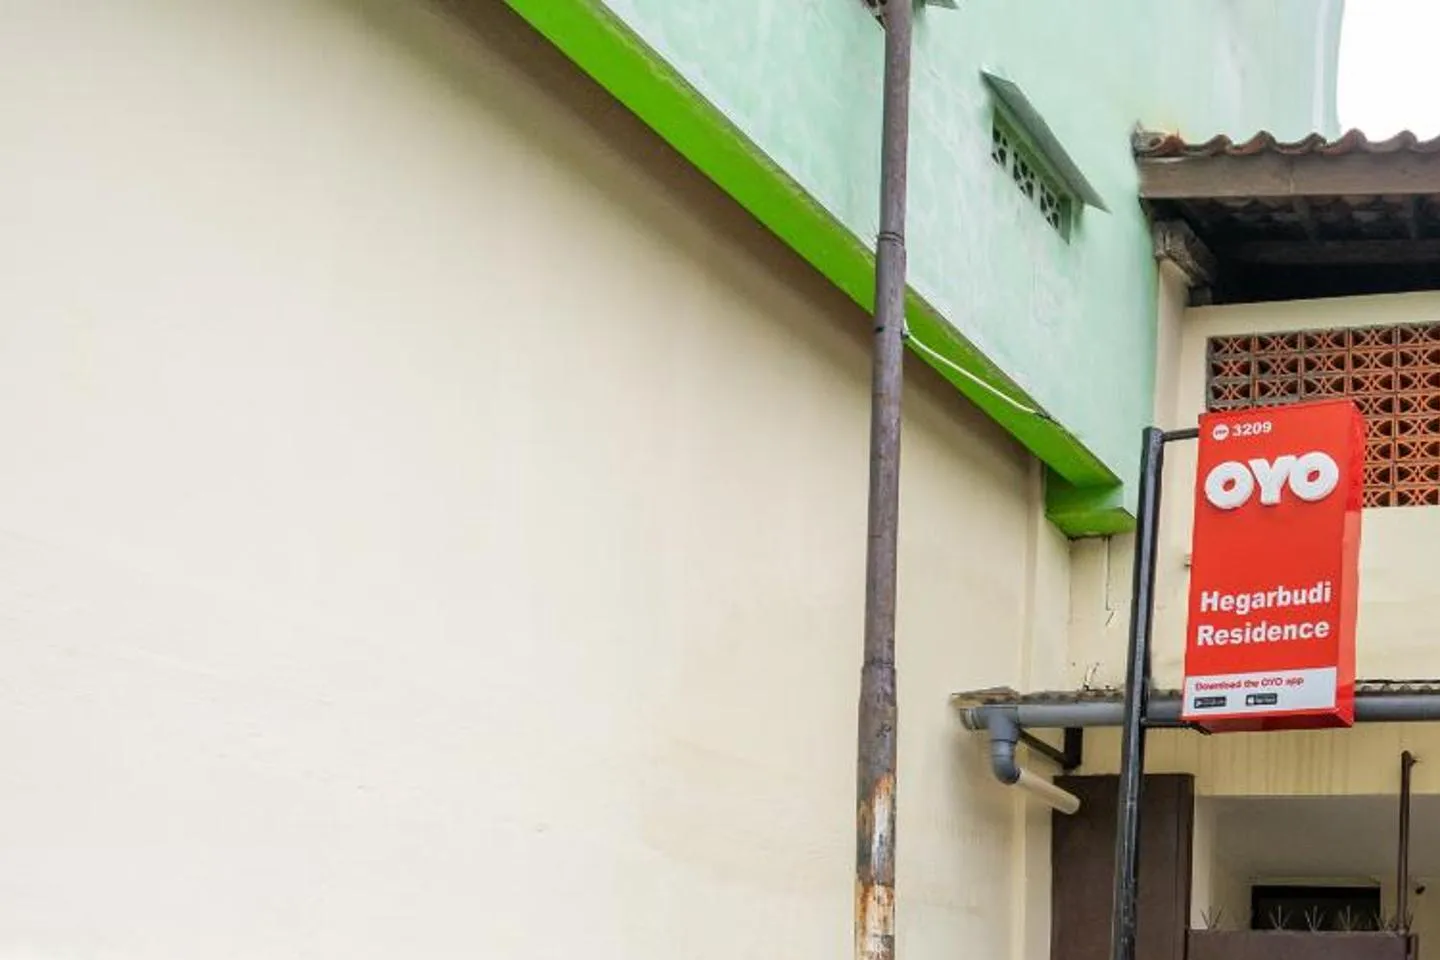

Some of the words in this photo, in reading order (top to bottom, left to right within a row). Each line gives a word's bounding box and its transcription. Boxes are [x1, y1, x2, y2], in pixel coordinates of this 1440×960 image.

[1231, 421, 1273, 437] 3209
[1204, 451, 1340, 510] OYO
[1200, 581, 1332, 615] Hegarbudi
[1197, 621, 1330, 646] Residence
[1195, 680, 1242, 691] Download
[1244, 678, 1260, 689] the
[1261, 677, 1283, 688] OYO
[1285, 677, 1304, 688] app
